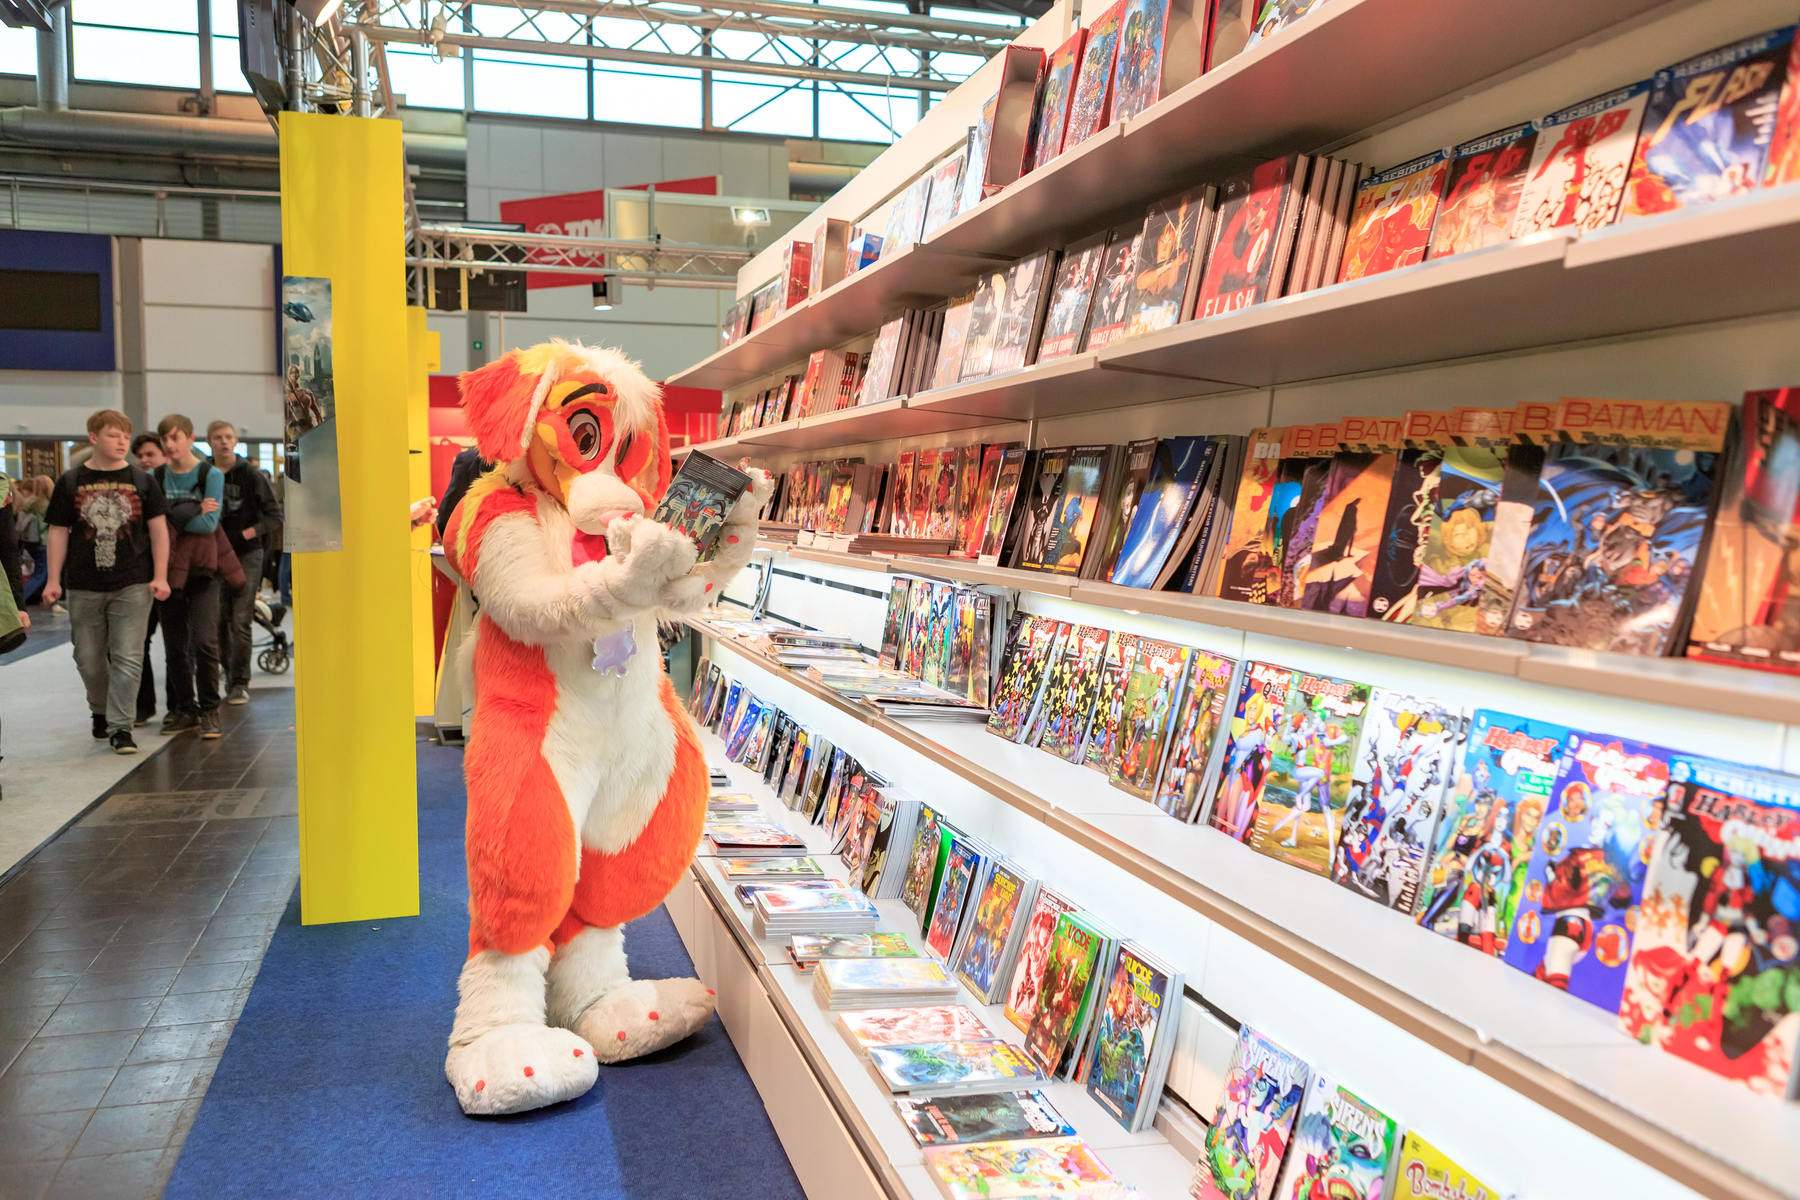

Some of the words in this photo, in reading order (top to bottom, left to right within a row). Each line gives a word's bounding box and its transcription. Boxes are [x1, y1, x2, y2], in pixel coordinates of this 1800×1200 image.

[1557, 91, 1630, 123] REBIRTH
[1460, 129, 1524, 157] REBIRTH
[1381, 158, 1436, 183] REBIRTH
[1358, 175, 1438, 237] FLASH
[1131, 305, 1175, 323] WONDER
[1203, 289, 1256, 318] FLASH
[1041, 340, 1058, 356] HARLEY
[1089, 330, 1109, 346] HARLEY
[992, 346, 1022, 369] JOKER
[1562, 401, 1722, 435] BATMAN
[1194, 460, 1206, 484] BATMAN
[1201, 527, 1209, 538] DES
[1194, 538, 1206, 565] DUNKLEN
[1187, 564, 1199, 587] RITTERS
[1142, 642, 1177, 659] HARLEY
[1298, 674, 1355, 697] HARLEY
[1482, 725, 1559, 755] HARLEY
[1692, 791, 1795, 829] HARLEY
[994, 872, 1017, 895] SUICIDE
[1064, 921, 1092, 951] SUICIDE
[1124, 955, 1154, 985] SUICIDE
[1133, 978, 1161, 1009] SQUAD
[1242, 1037, 1296, 1097] SIRENS
[1327, 1094, 1387, 1160] SIRENS
